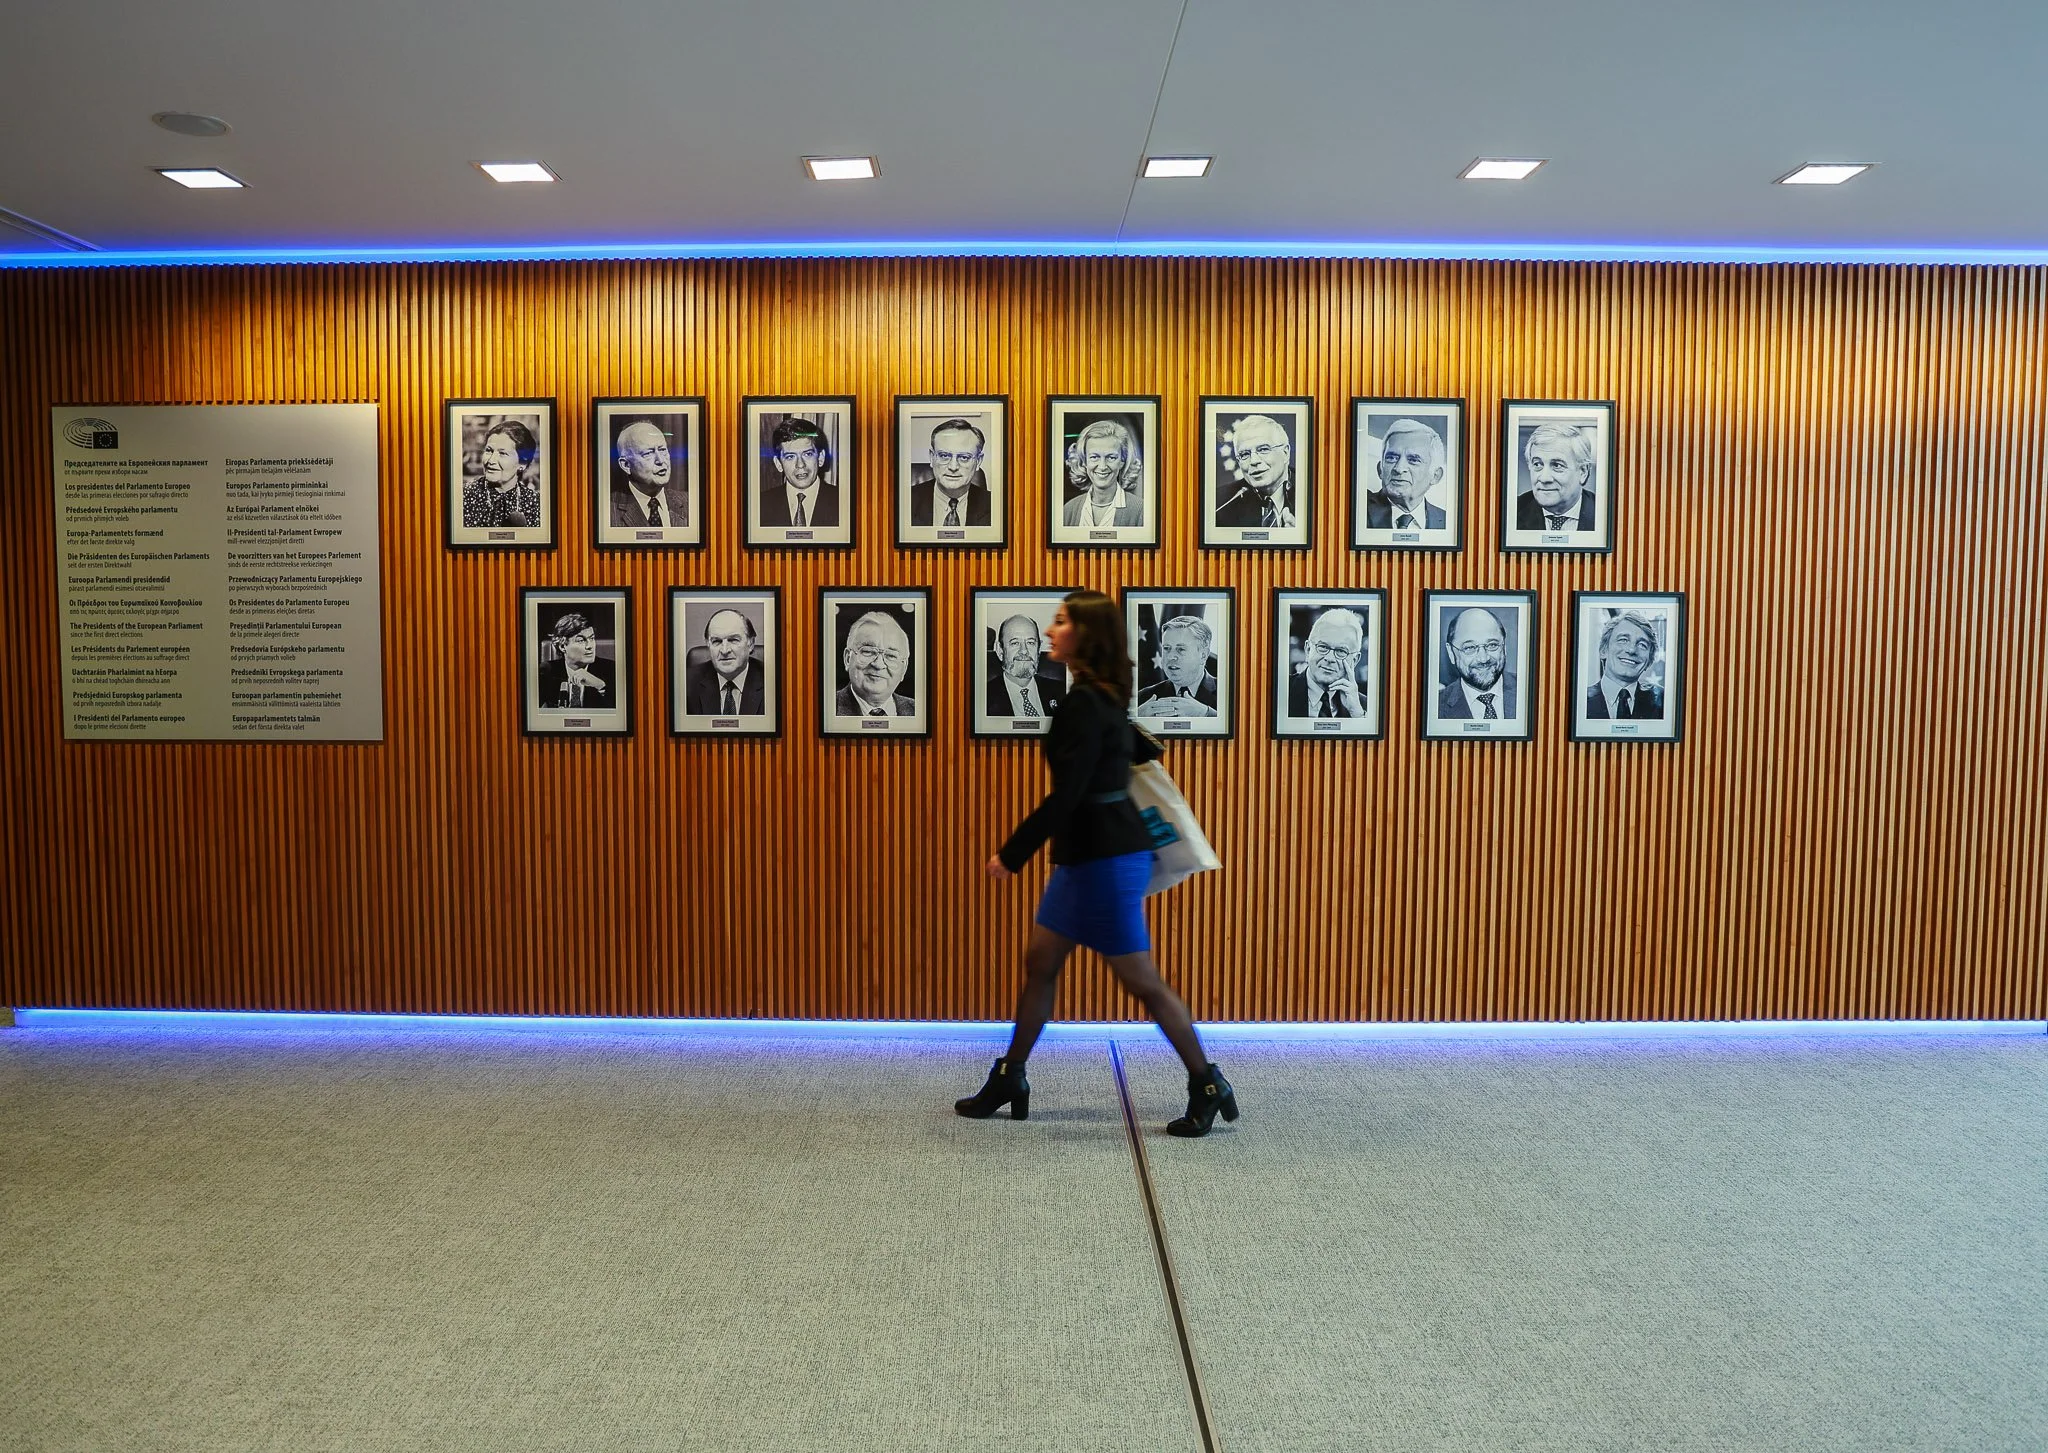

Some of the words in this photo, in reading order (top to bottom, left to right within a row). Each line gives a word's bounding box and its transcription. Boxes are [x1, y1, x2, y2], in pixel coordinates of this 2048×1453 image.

[226, 458, 248, 467] Eiropas
[77, 483, 114, 491] presidentes
[165, 482, 191, 491] Europeo
[226, 482, 251, 490] Europos
[291, 481, 329, 490] pirmininkai
[141, 506, 178, 515] parlamentu
[67, 529, 133, 538] Europa-Parlamentets
[314, 528, 342, 537] Ewropew
[298, 552, 327, 560] Europees
[69, 576, 94, 585] Euroopa
[133, 576, 170, 584] presidendid
[318, 575, 362, 584] Europejskiego
[324, 598, 350, 607] Europeu
[138, 622, 167, 631] European
[312, 622, 342, 630] European
[308, 645, 345, 654] parlamentu
[156, 668, 177, 677] hEorpa
[270, 668, 305, 677] Evropskega
[306, 668, 343, 677] parlamenta
[73, 691, 111, 700] Predsjednici
[112, 691, 145, 700] Europskog
[146, 691, 182, 700] parlamenta
[232, 692, 262, 700] Euroopan
[263, 692, 302, 700] parlamentin
[303, 692, 342, 700] puhemiehet
[233, 715, 296, 723] Europaparlamentets
